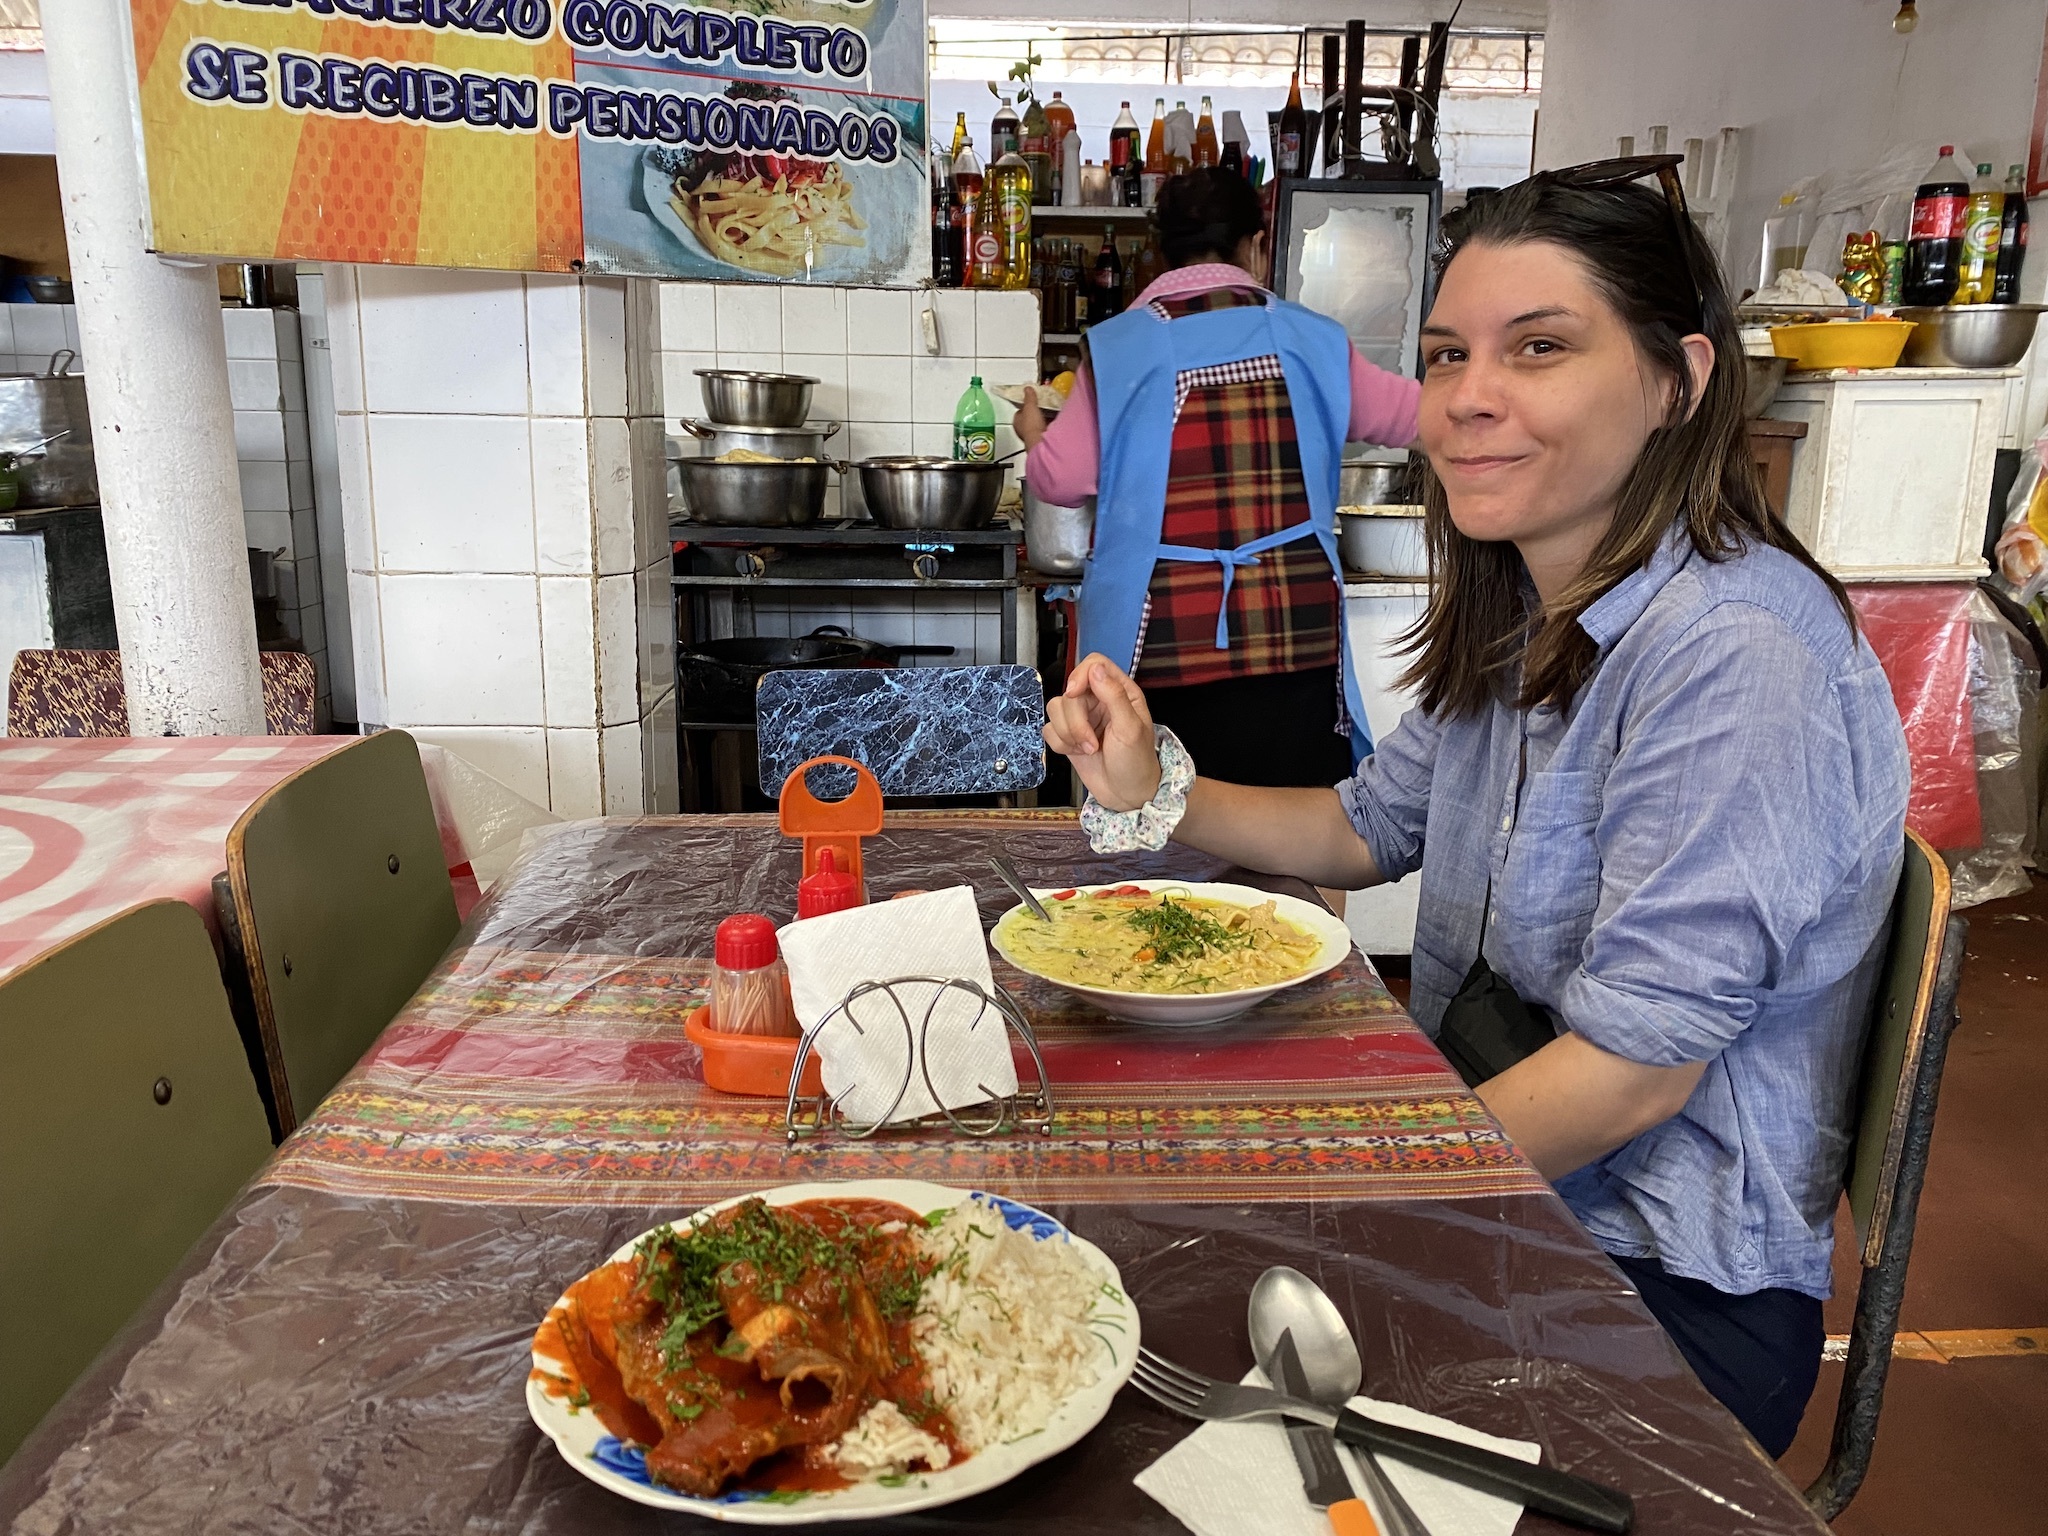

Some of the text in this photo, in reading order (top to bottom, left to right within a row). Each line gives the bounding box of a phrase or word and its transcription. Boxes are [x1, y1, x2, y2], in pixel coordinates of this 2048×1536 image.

[221, 0, 868, 77] ERZO COMPLETO
[186, 43, 897, 160] SE RECIBEN PENSIONADOS
